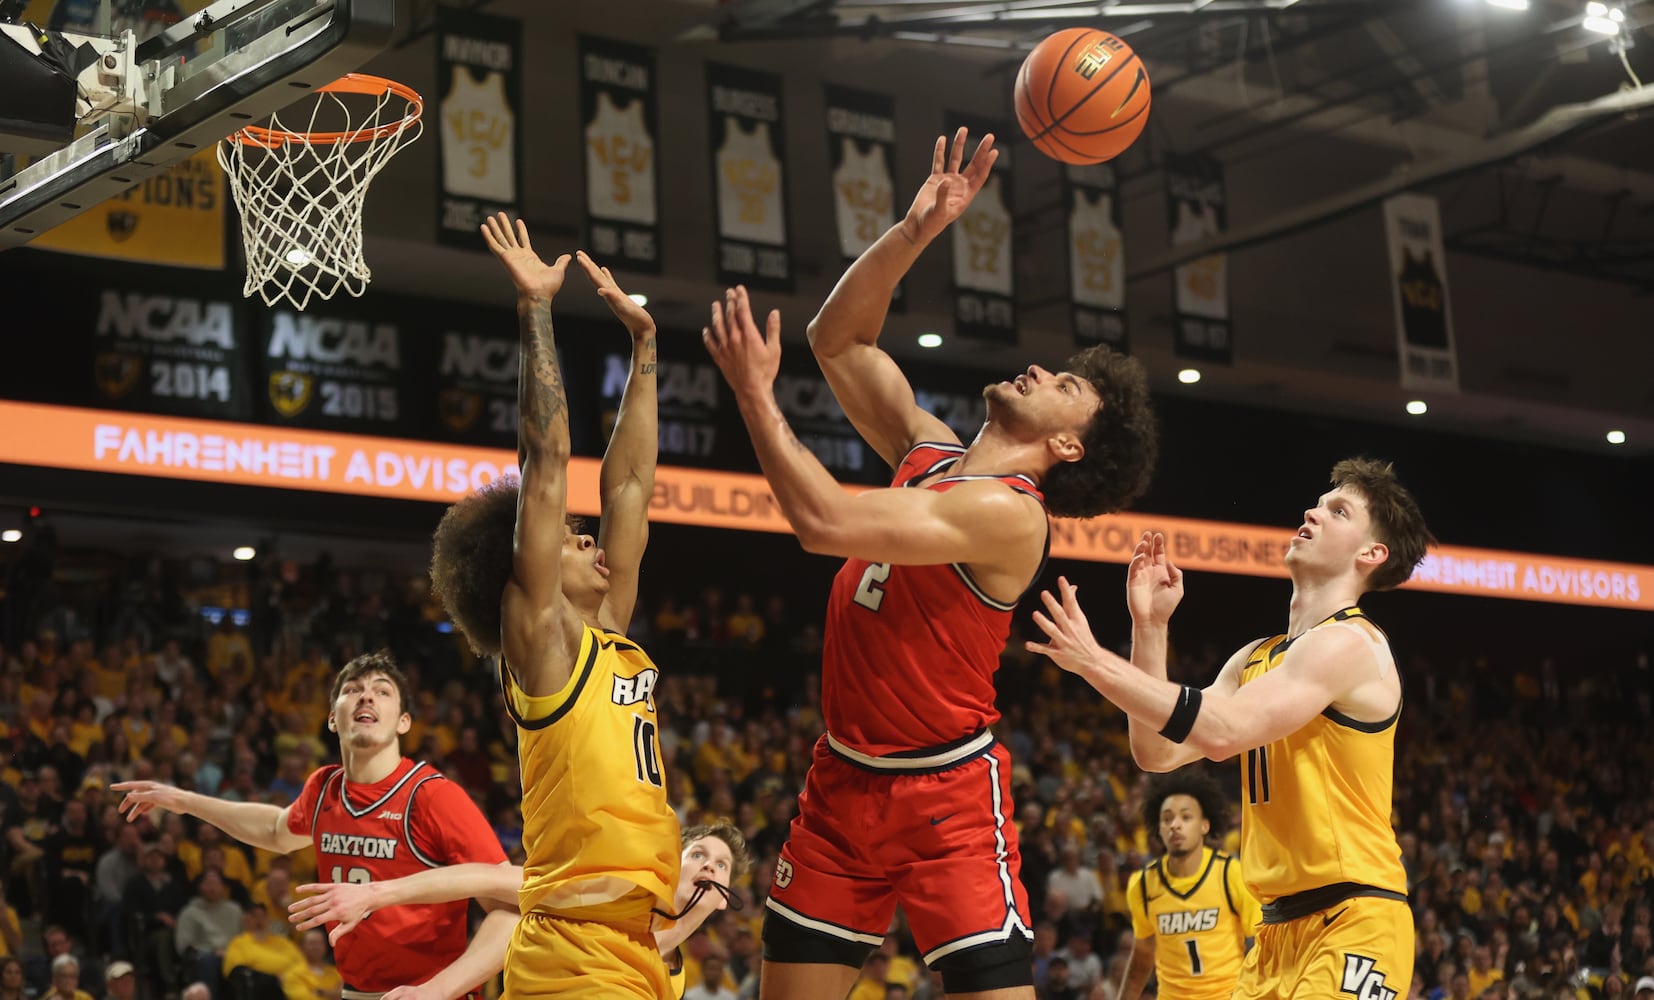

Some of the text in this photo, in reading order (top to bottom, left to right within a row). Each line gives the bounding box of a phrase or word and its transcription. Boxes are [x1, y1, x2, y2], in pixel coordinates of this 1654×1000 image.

[448, 110, 509, 150] VCU
[469, 146, 489, 179] 3
[588, 135, 652, 173] VCU
[611, 170, 632, 205] 5
[96, 290, 236, 350] NCAA
[267, 312, 400, 369] NCAA
[150, 362, 231, 402] 2014
[320, 381, 398, 421] 2015
[94, 424, 336, 480] FAHRENHEIT
[657, 423, 717, 456] 017
[853, 562, 891, 613] 2
[1522, 564, 1641, 602] ADVISORS
[612, 668, 659, 712] RA
[632, 713, 662, 788] 10
[320, 832, 398, 860] DAYTON
[1157, 908, 1220, 936] RAMS
[1182, 939, 1203, 977] 1
